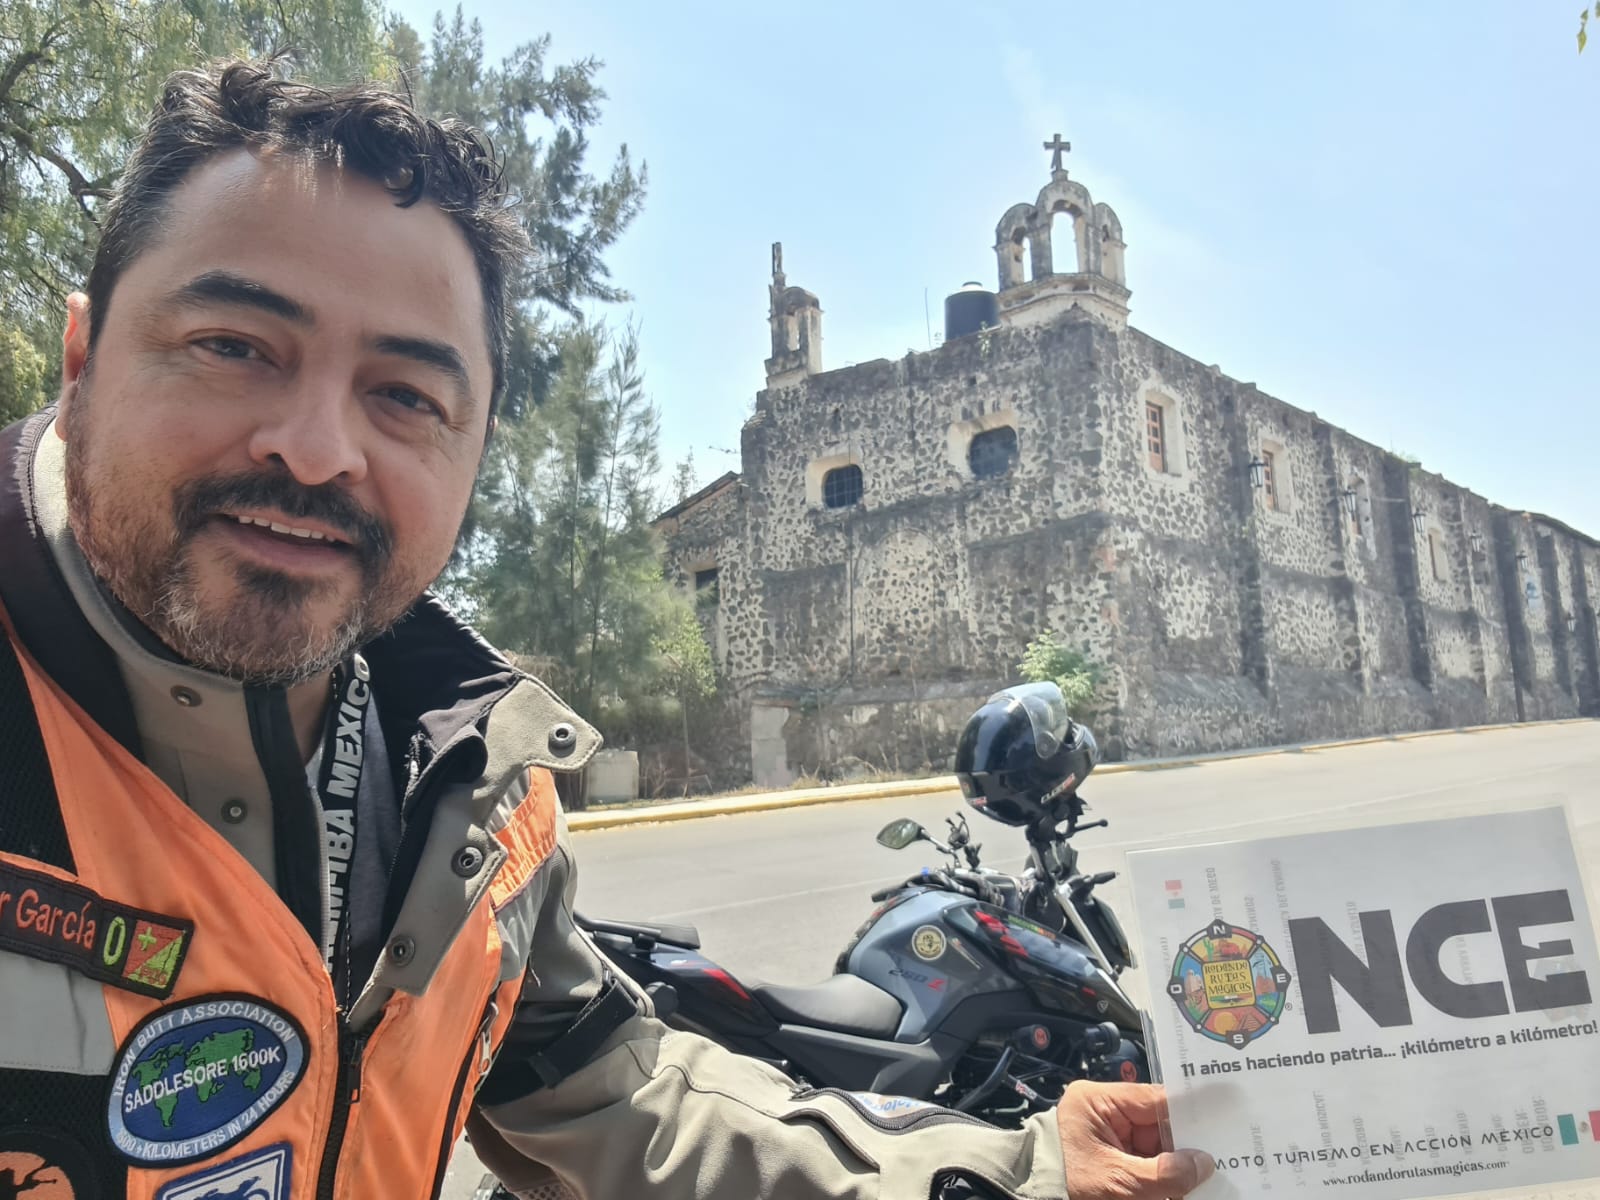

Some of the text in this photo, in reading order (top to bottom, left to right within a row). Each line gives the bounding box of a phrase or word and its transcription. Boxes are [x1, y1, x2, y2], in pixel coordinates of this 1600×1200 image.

[327, 653, 370, 798] MEXICO
[16, 889, 96, 950] García
[1288, 889, 1592, 1034] NCE
[113, 1003, 295, 1096] IRON BUTT ASSOCIATION
[1181, 1020, 1599, 1077] 11 años haciendo patria... ¡kilómetro a kilómetro!
[1233, 1034, 1244, 1044] S
[125, 1046, 281, 1113] SADDLESORE 1600K
[142, 1129, 227, 1158] KILOMETERS
[229, 1120, 241, 1139] IN
[243, 1109, 257, 1129] 24
[257, 1070, 295, 1112] HOURS
[1213, 1154, 1265, 1171] MOTO
[1273, 1146, 1361, 1165] TURISMO
[1370, 1143, 1394, 1157] EN
[1404, 1134, 1471, 1152] ACCIÓN
[1322, 1161, 1507, 1187] www.rodandorutasmagicas.com
